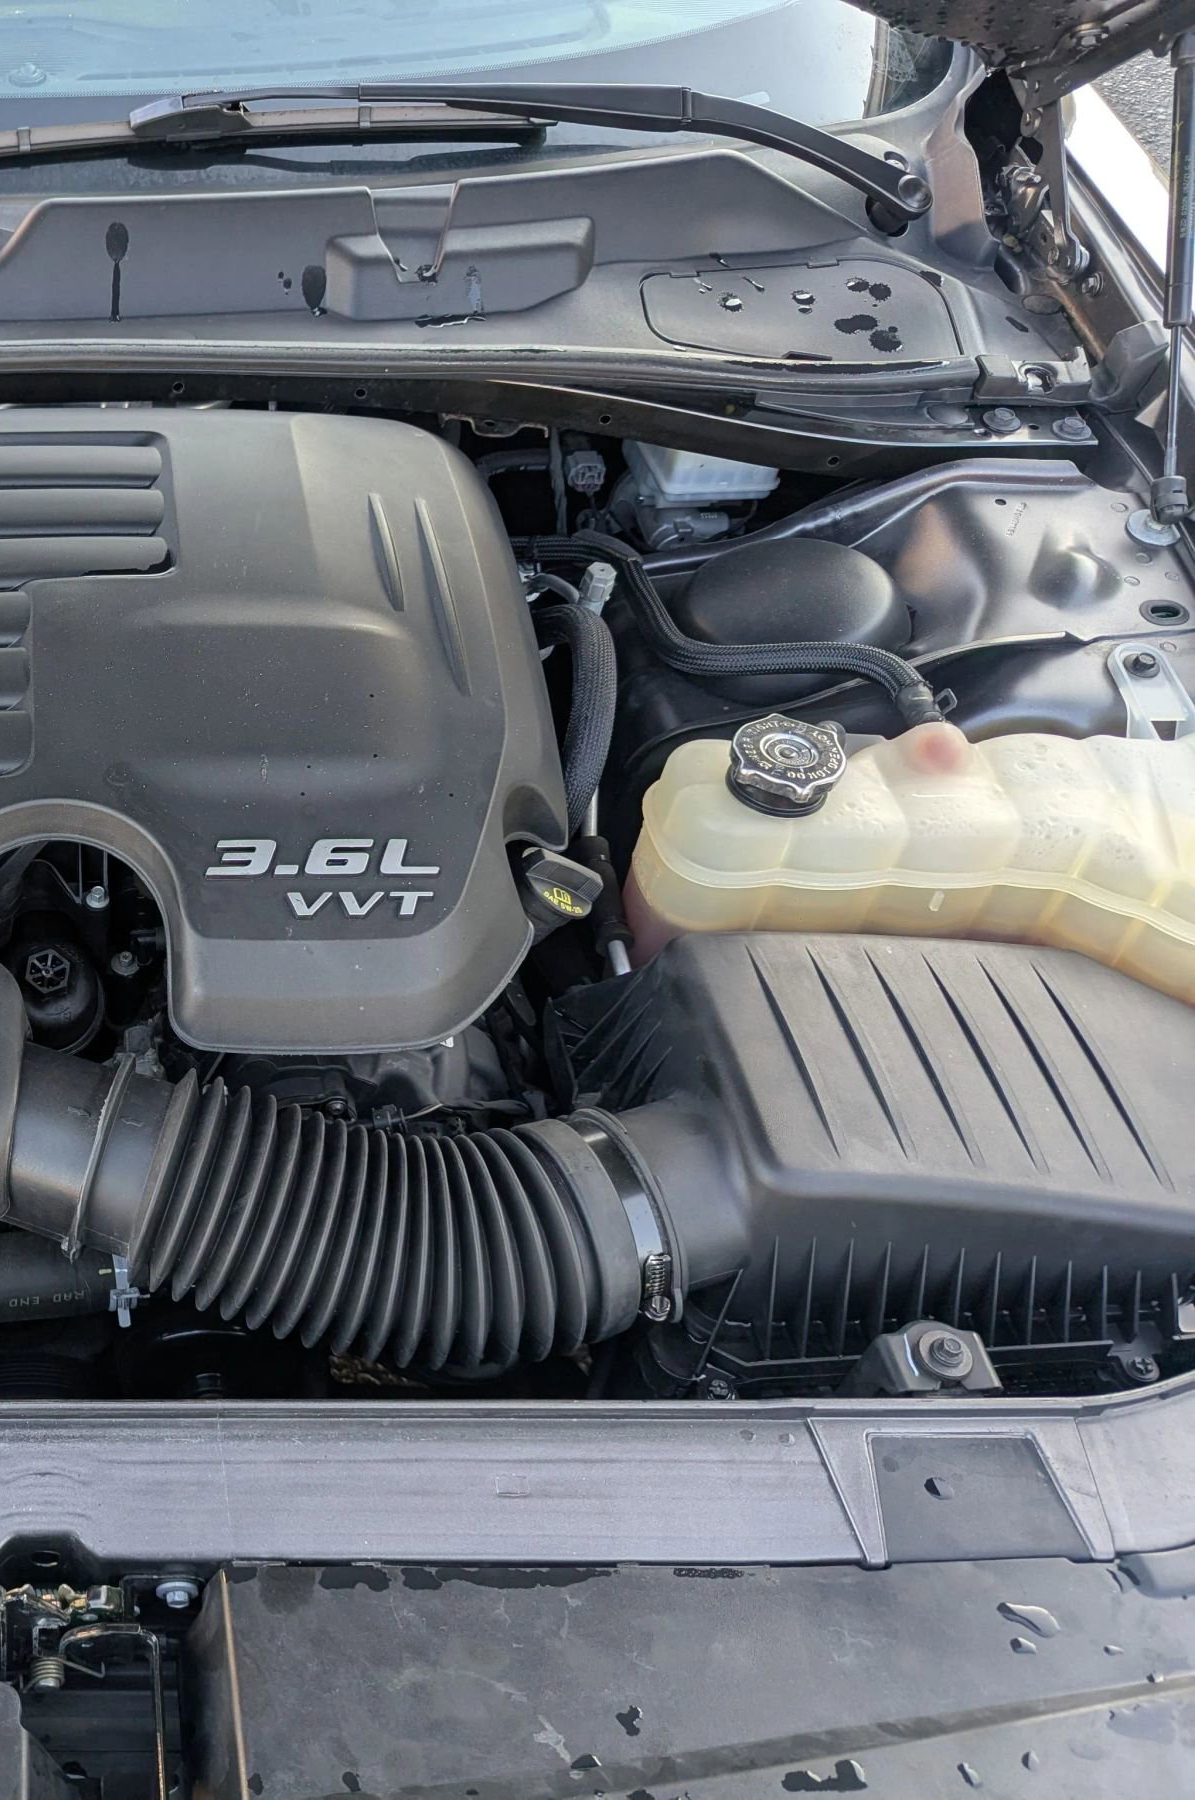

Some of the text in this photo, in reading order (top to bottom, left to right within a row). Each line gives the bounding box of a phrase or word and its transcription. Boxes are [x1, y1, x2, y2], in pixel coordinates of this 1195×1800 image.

[746, 720, 779, 735] TIGHT
[787, 730, 841, 780] DO NOT OPEN HOT
[205, 838, 441, 877] 3.6L
[286, 891, 435, 919] VVT
[543, 890, 559, 906] SAE
[8, 1295, 41, 1308] END
[52, 1289, 86, 1303] RAD
